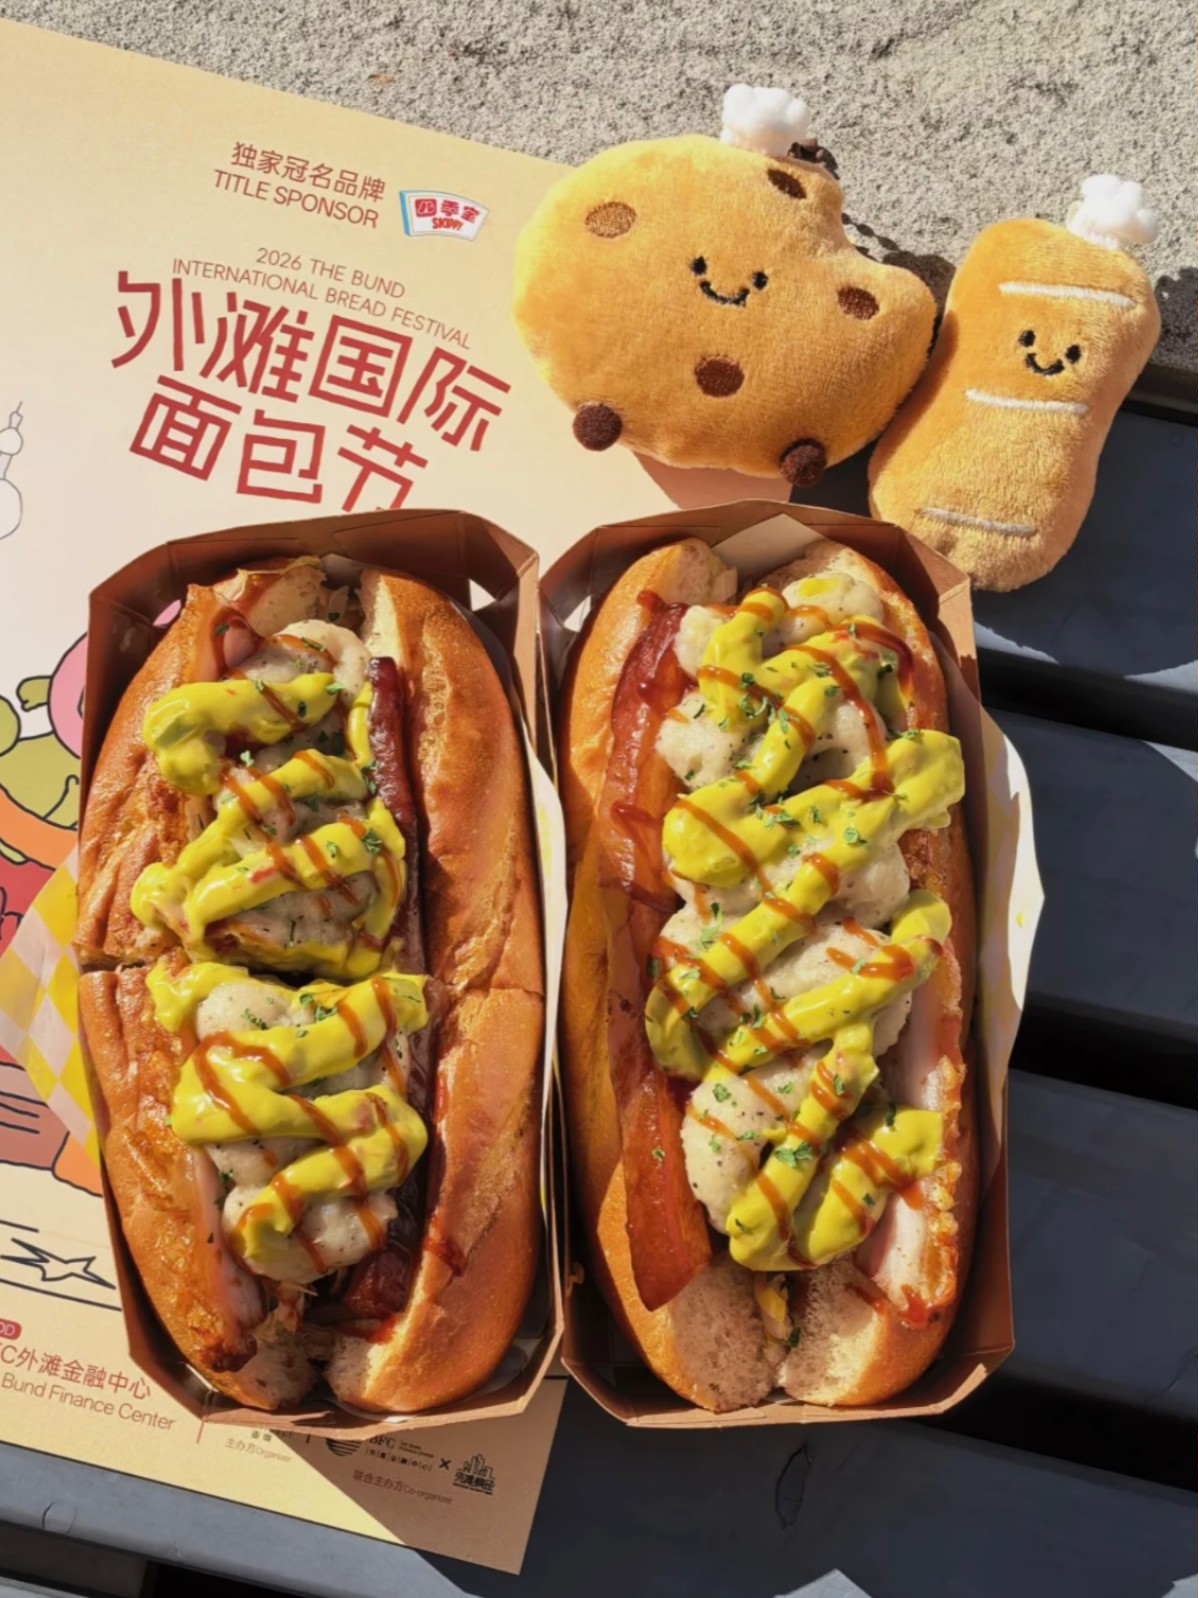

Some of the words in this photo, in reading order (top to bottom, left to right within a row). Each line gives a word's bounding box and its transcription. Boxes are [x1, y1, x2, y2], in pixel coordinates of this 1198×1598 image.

[214, 169, 271, 200] TITLE
[273, 186, 379, 229] SPONSOR
[231, 141, 386, 203] 独家冠名品牌
[256, 247, 302, 271] 2026
[310, 258, 346, 282] THE
[351, 269, 405, 299] BUND
[172, 258, 318, 300] INTERNATIONAL
[325, 287, 387, 317] BREAD
[391, 307, 471, 350] FESTIVAL
[111, 271, 511, 452] 外滩国际
[129, 375, 428, 513] 面包节
[0, 1342, 151, 1400] C外滩金融中心
[1, 1372, 47, 1397] Bund
[49, 1384, 115, 1415] Finance
[118, 1403, 177, 1430] Center
